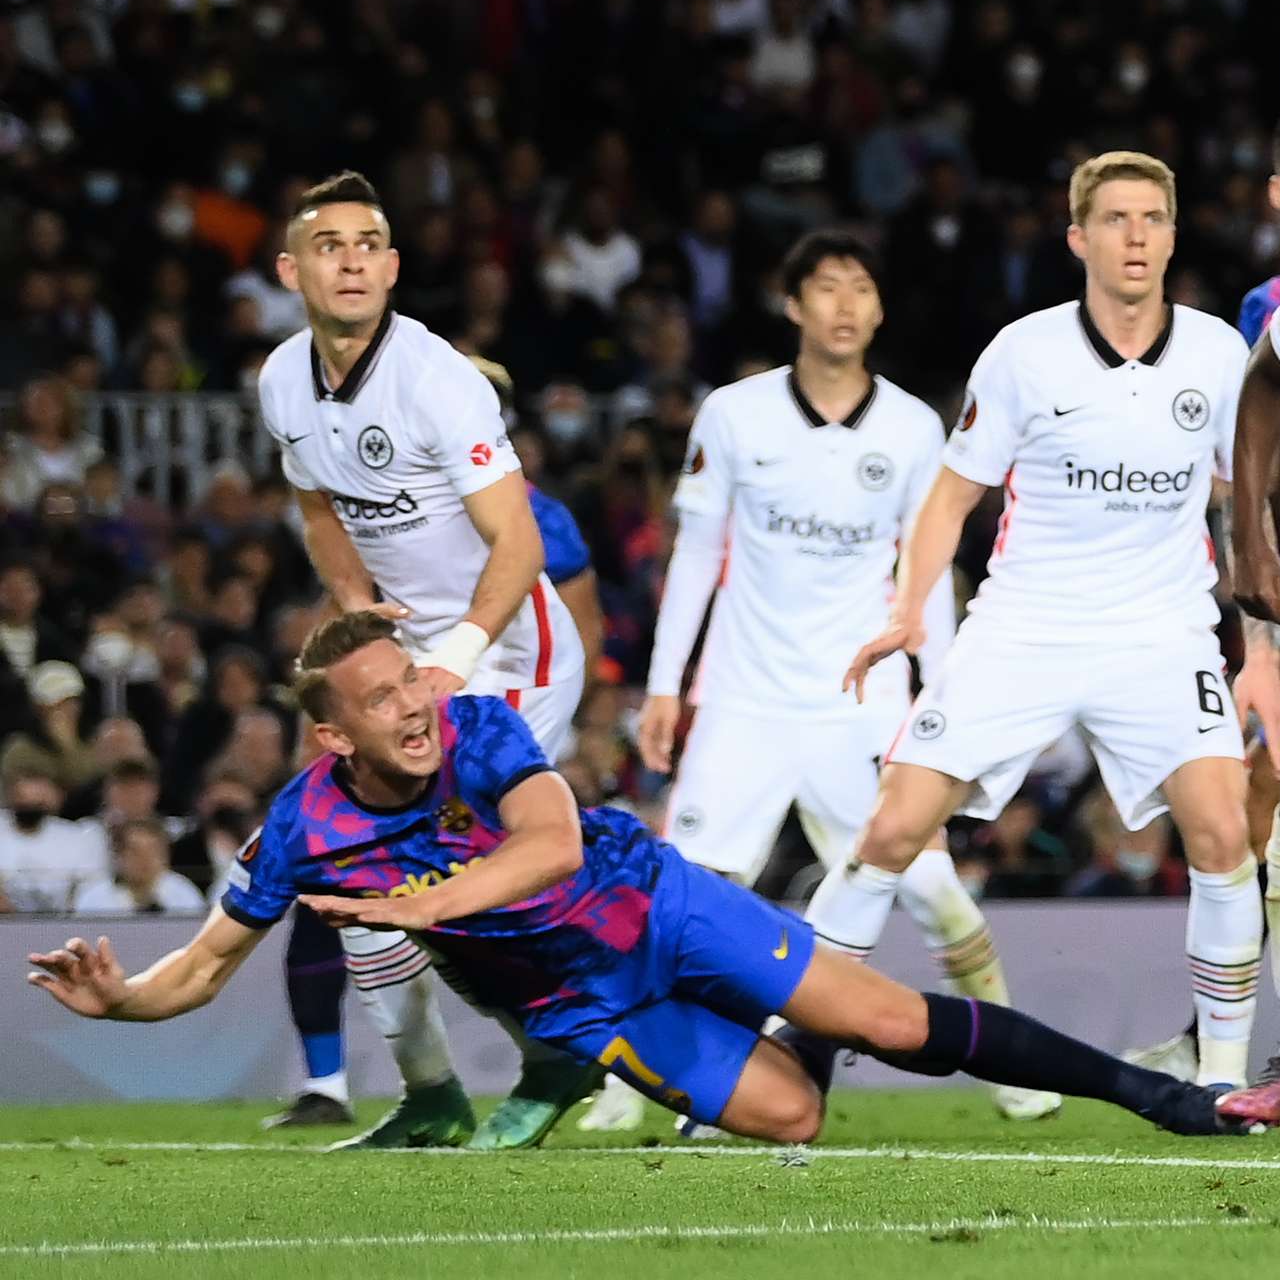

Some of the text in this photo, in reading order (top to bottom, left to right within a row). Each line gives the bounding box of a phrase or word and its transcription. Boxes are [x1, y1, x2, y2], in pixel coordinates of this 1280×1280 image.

[1065, 461, 1195, 494] indeed
[767, 508, 875, 546] indeed
[1195, 669, 1225, 717] 6
